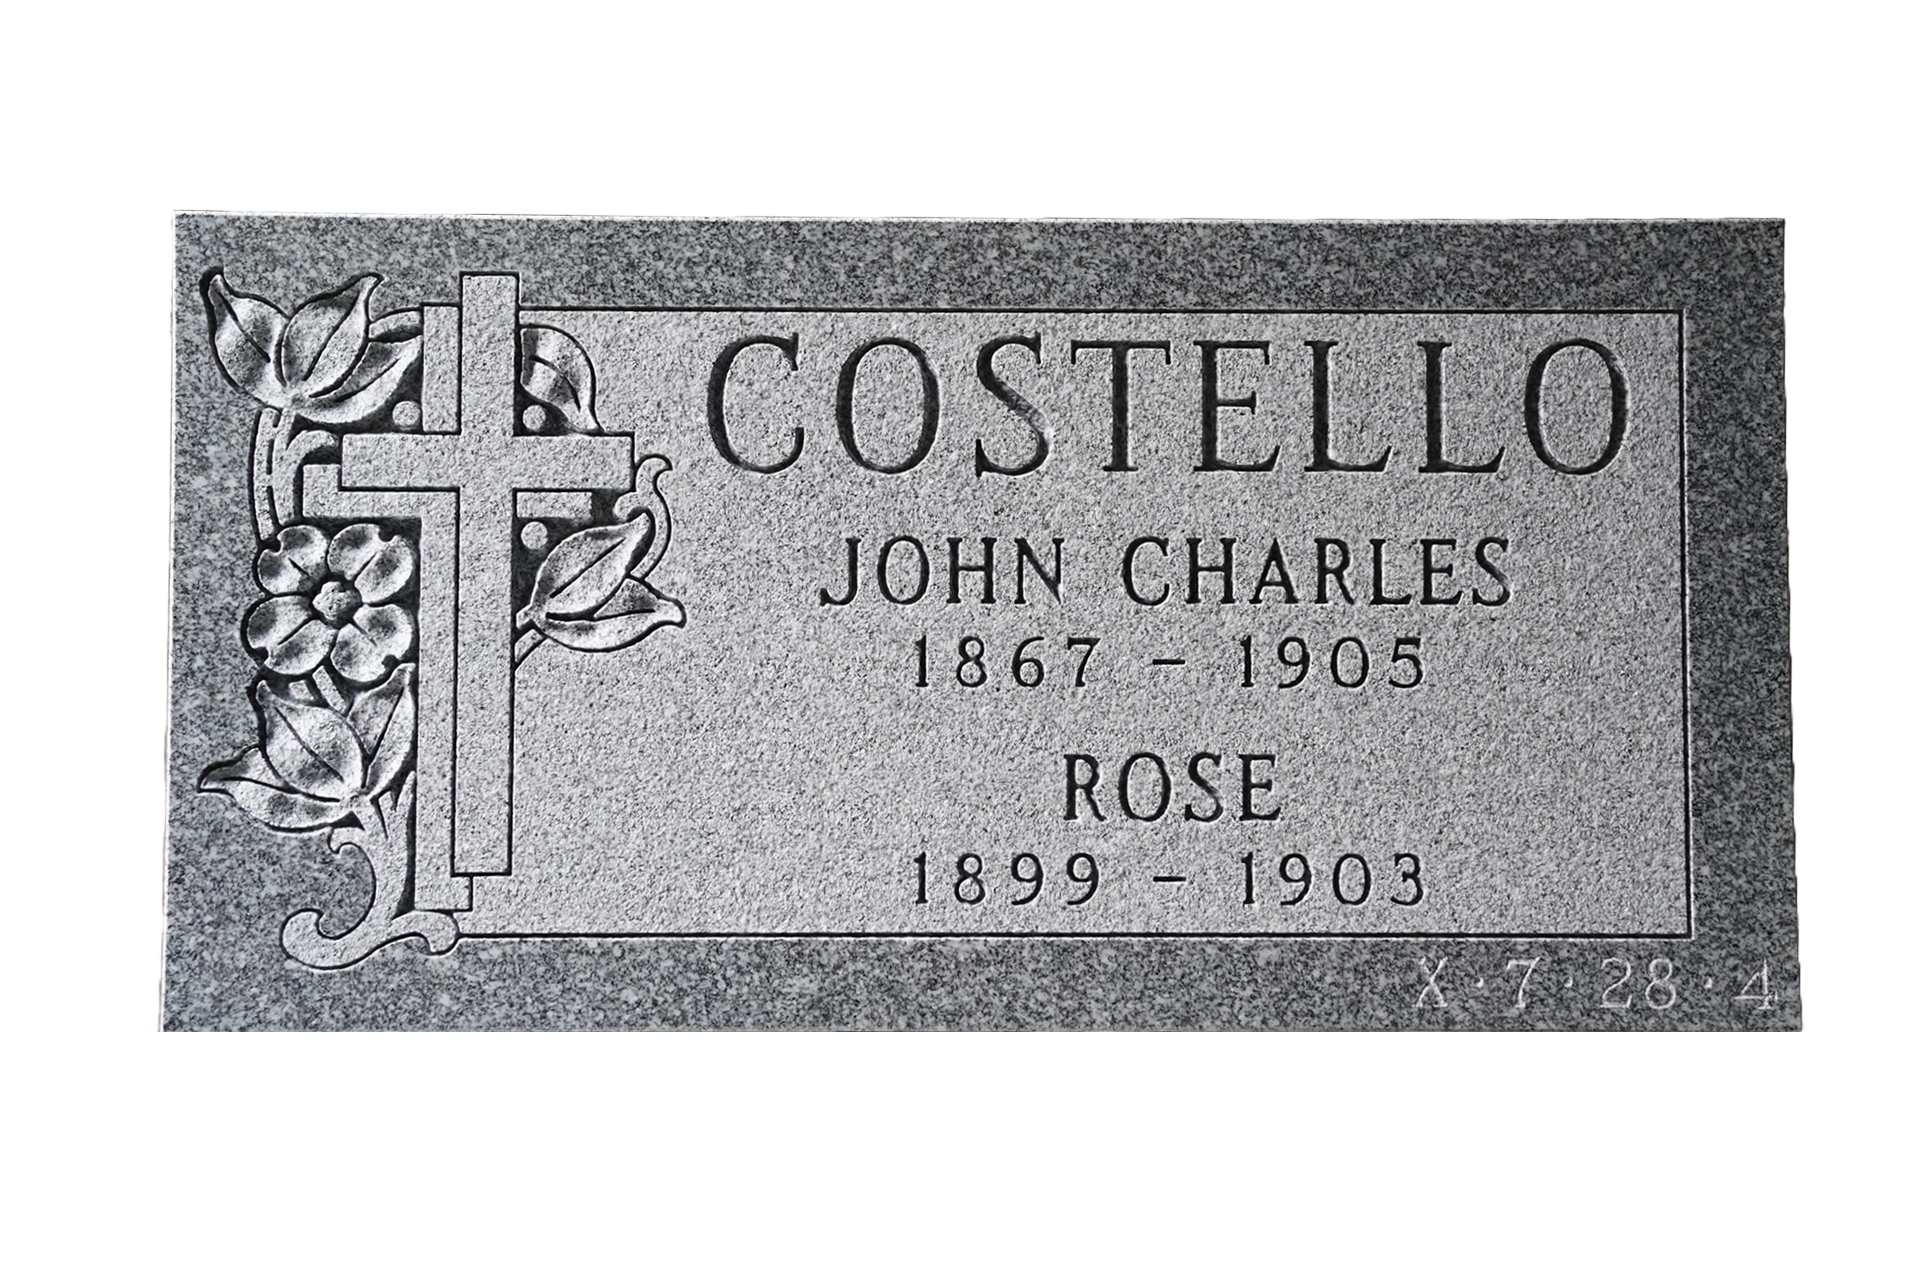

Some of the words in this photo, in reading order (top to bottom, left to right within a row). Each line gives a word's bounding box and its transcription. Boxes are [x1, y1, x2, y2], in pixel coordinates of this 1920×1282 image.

[706, 333, 1631, 478] COSTELLO
[819, 536, 1065, 607] JOHN
[1120, 535, 1513, 607] CHARLES
[914, 635, 1101, 689] 1867
[1239, 635, 1425, 690] 1905
[1061, 751, 1282, 823] ROSE
[914, 852, 1100, 905] 1899
[1241, 851, 1426, 906] 1903
